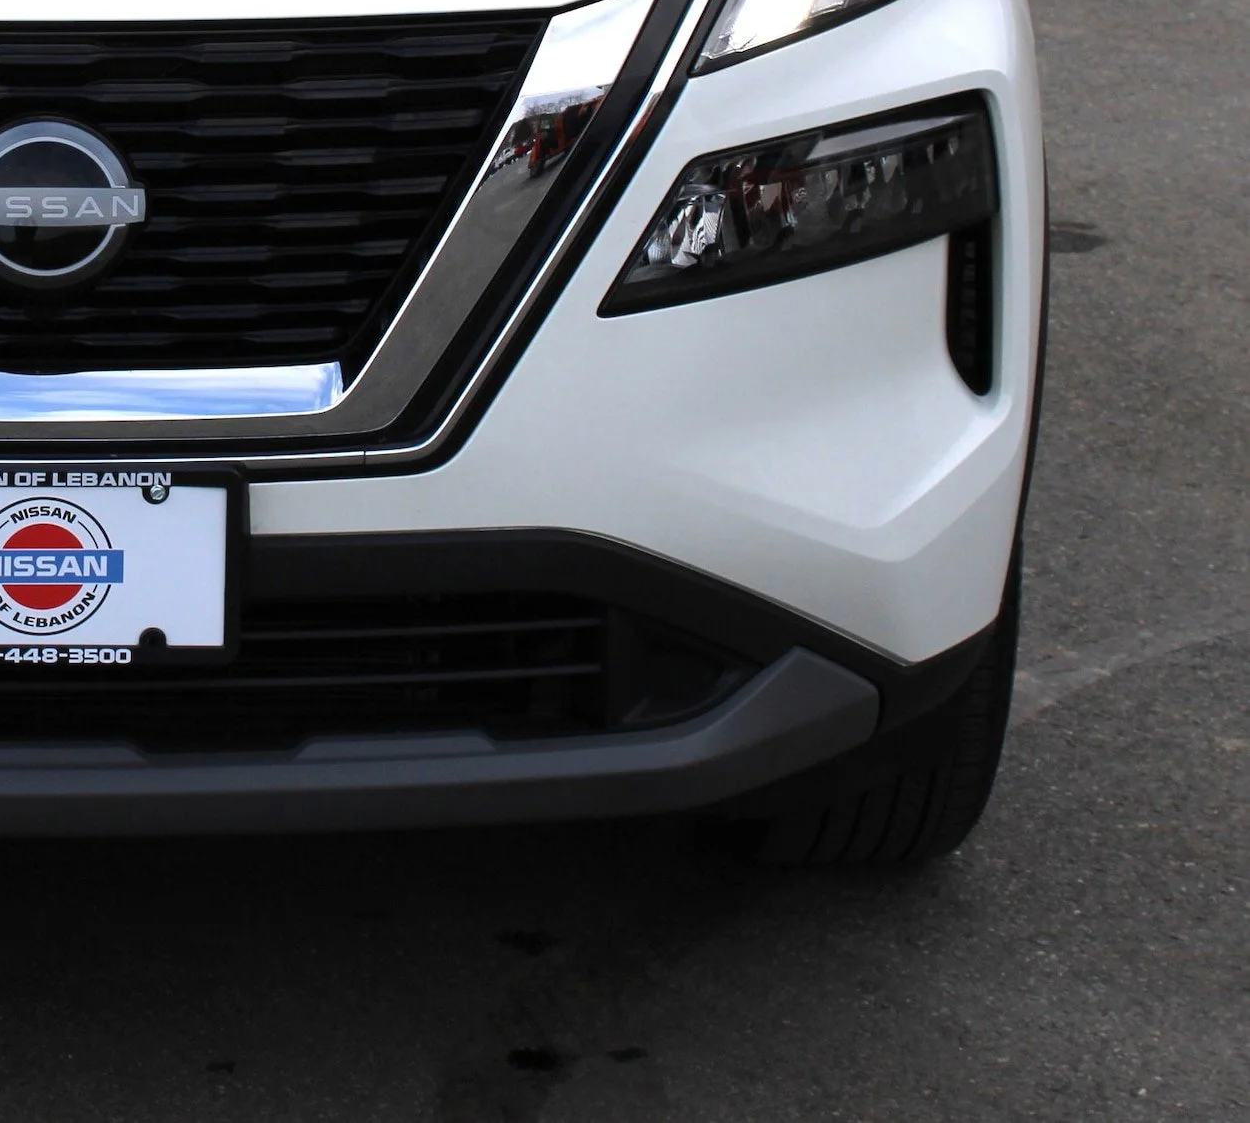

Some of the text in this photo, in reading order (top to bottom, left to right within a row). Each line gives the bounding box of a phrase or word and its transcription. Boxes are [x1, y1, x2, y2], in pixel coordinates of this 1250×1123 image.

[14, 472, 46, 487] OF
[52, 471, 172, 487] LEBANON
[10, 505, 77, 524] NISSAN
[12, 591, 96, 628] LEBANON
